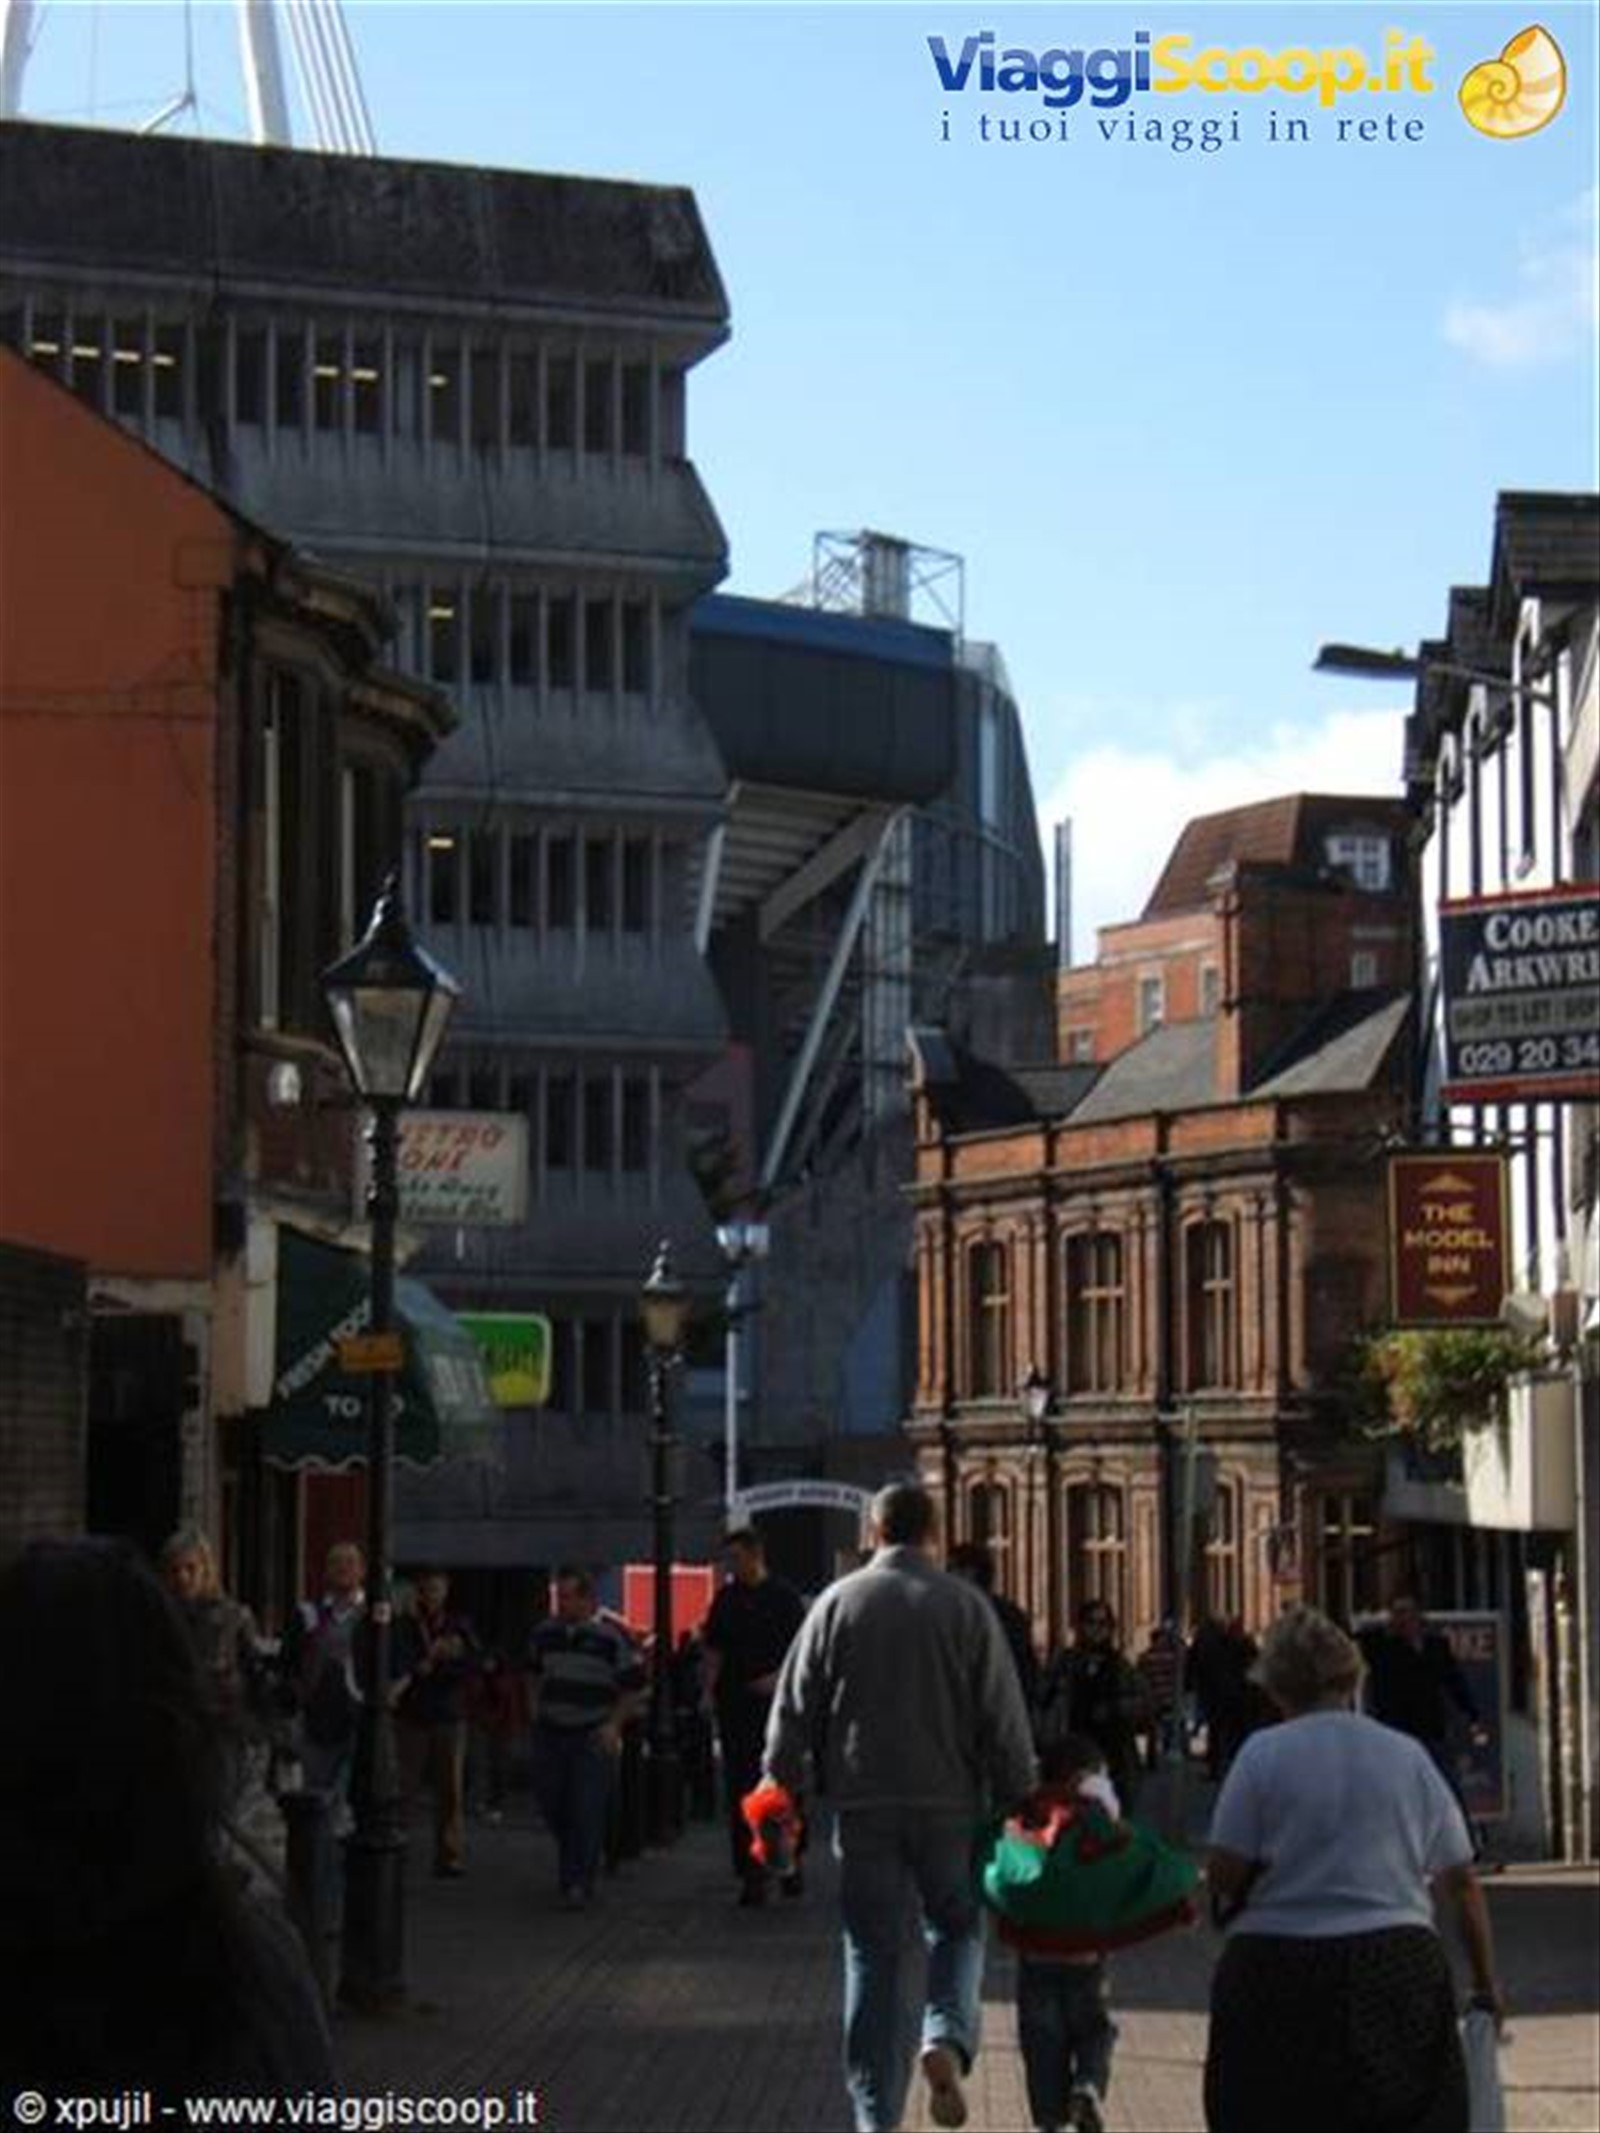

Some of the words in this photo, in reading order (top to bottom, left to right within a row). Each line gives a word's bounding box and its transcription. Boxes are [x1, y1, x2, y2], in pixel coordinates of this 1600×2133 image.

[1484, 908, 1598, 950] COOKE
[1459, 1042, 1513, 1074] 029
[1518, 1039, 1557, 1070] 20
[1420, 1203, 1475, 1222] THE
[1403, 1229, 1495, 1249] MODEL
[1427, 1255, 1471, 1274] INN
[325, 1396, 361, 1417] TO
